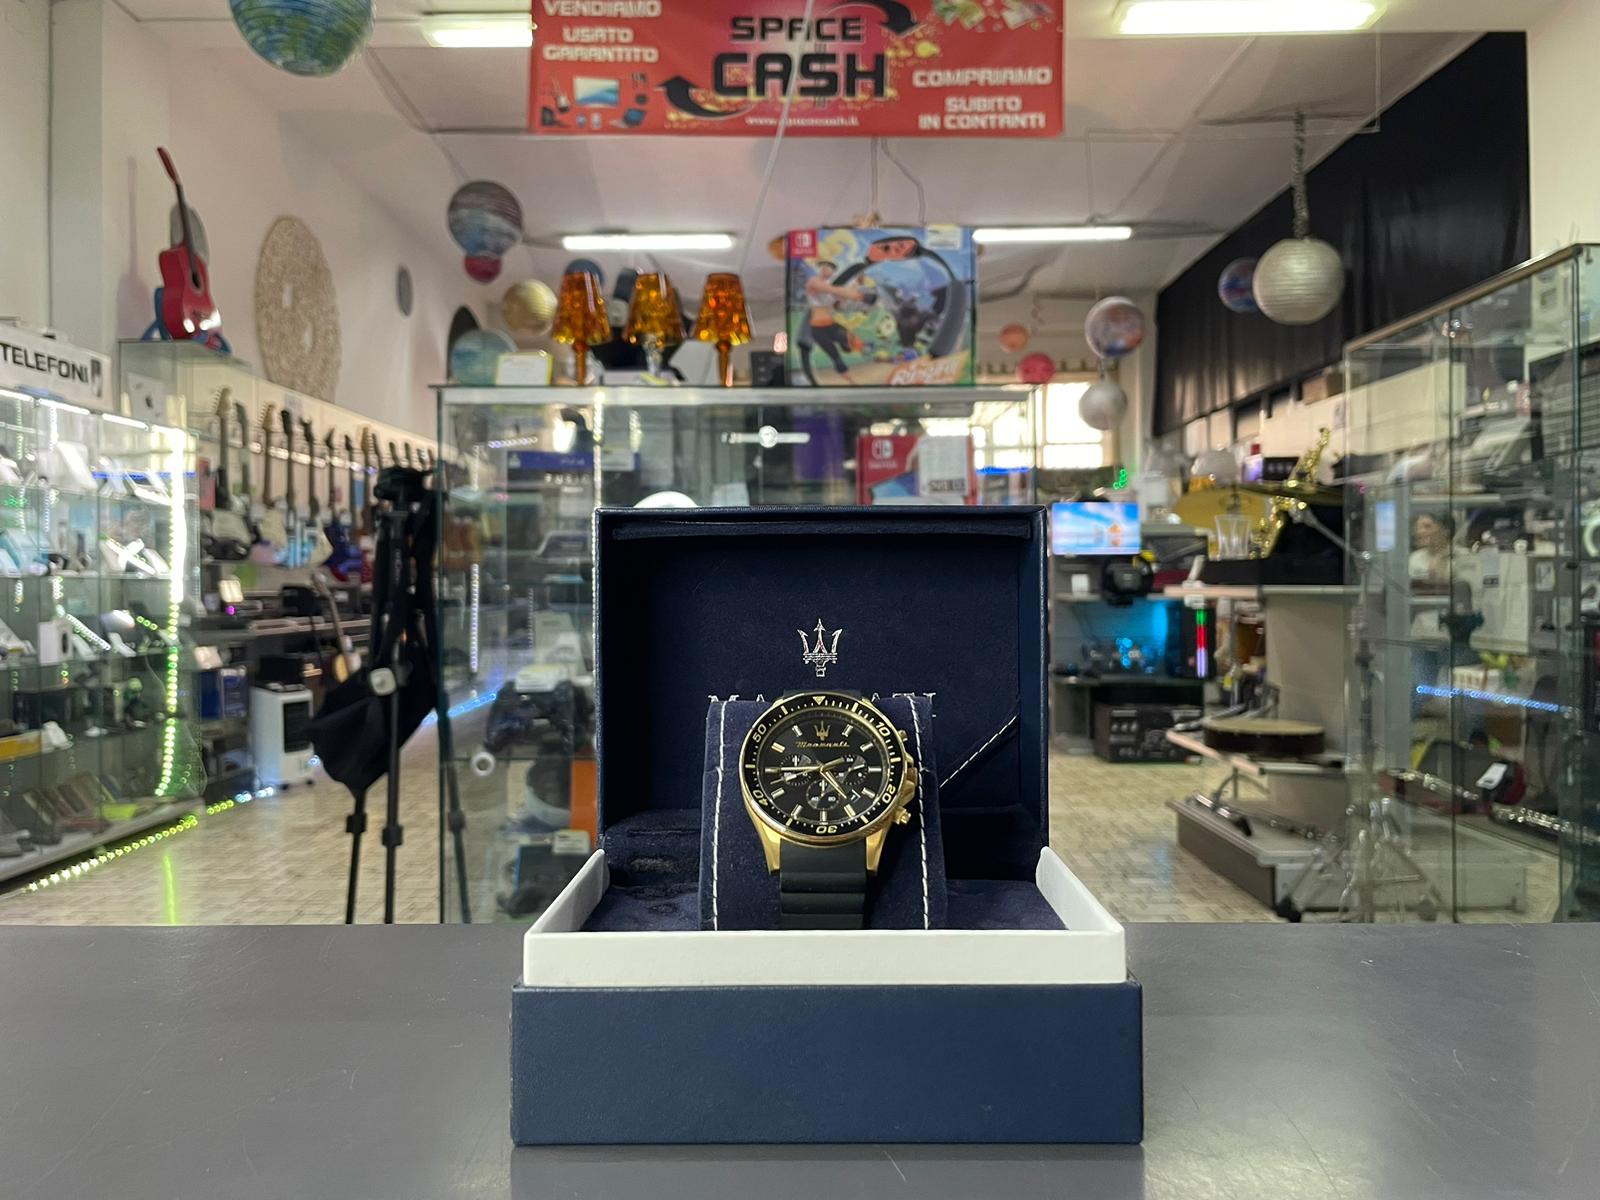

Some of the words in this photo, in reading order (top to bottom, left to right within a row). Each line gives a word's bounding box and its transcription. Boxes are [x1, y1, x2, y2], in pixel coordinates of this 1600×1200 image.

[543, 0, 662, 17] VENDIAMO
[562, 26, 635, 43] USATO
[731, 17, 864, 42] SPACE
[543, 45, 660, 63] GARANTITO
[713, 52, 885, 98] CASH
[911, 66, 1054, 88] COMPRIAMO
[944, 96, 1023, 112] SUBITO
[918, 112, 941, 130] IN
[944, 112, 1047, 130] CONTANTI
[0, 342, 89, 384] TELEFONI
[752, 723, 767, 743] 50
[876, 721, 891, 737] 10
[882, 783, 896, 804] 20
